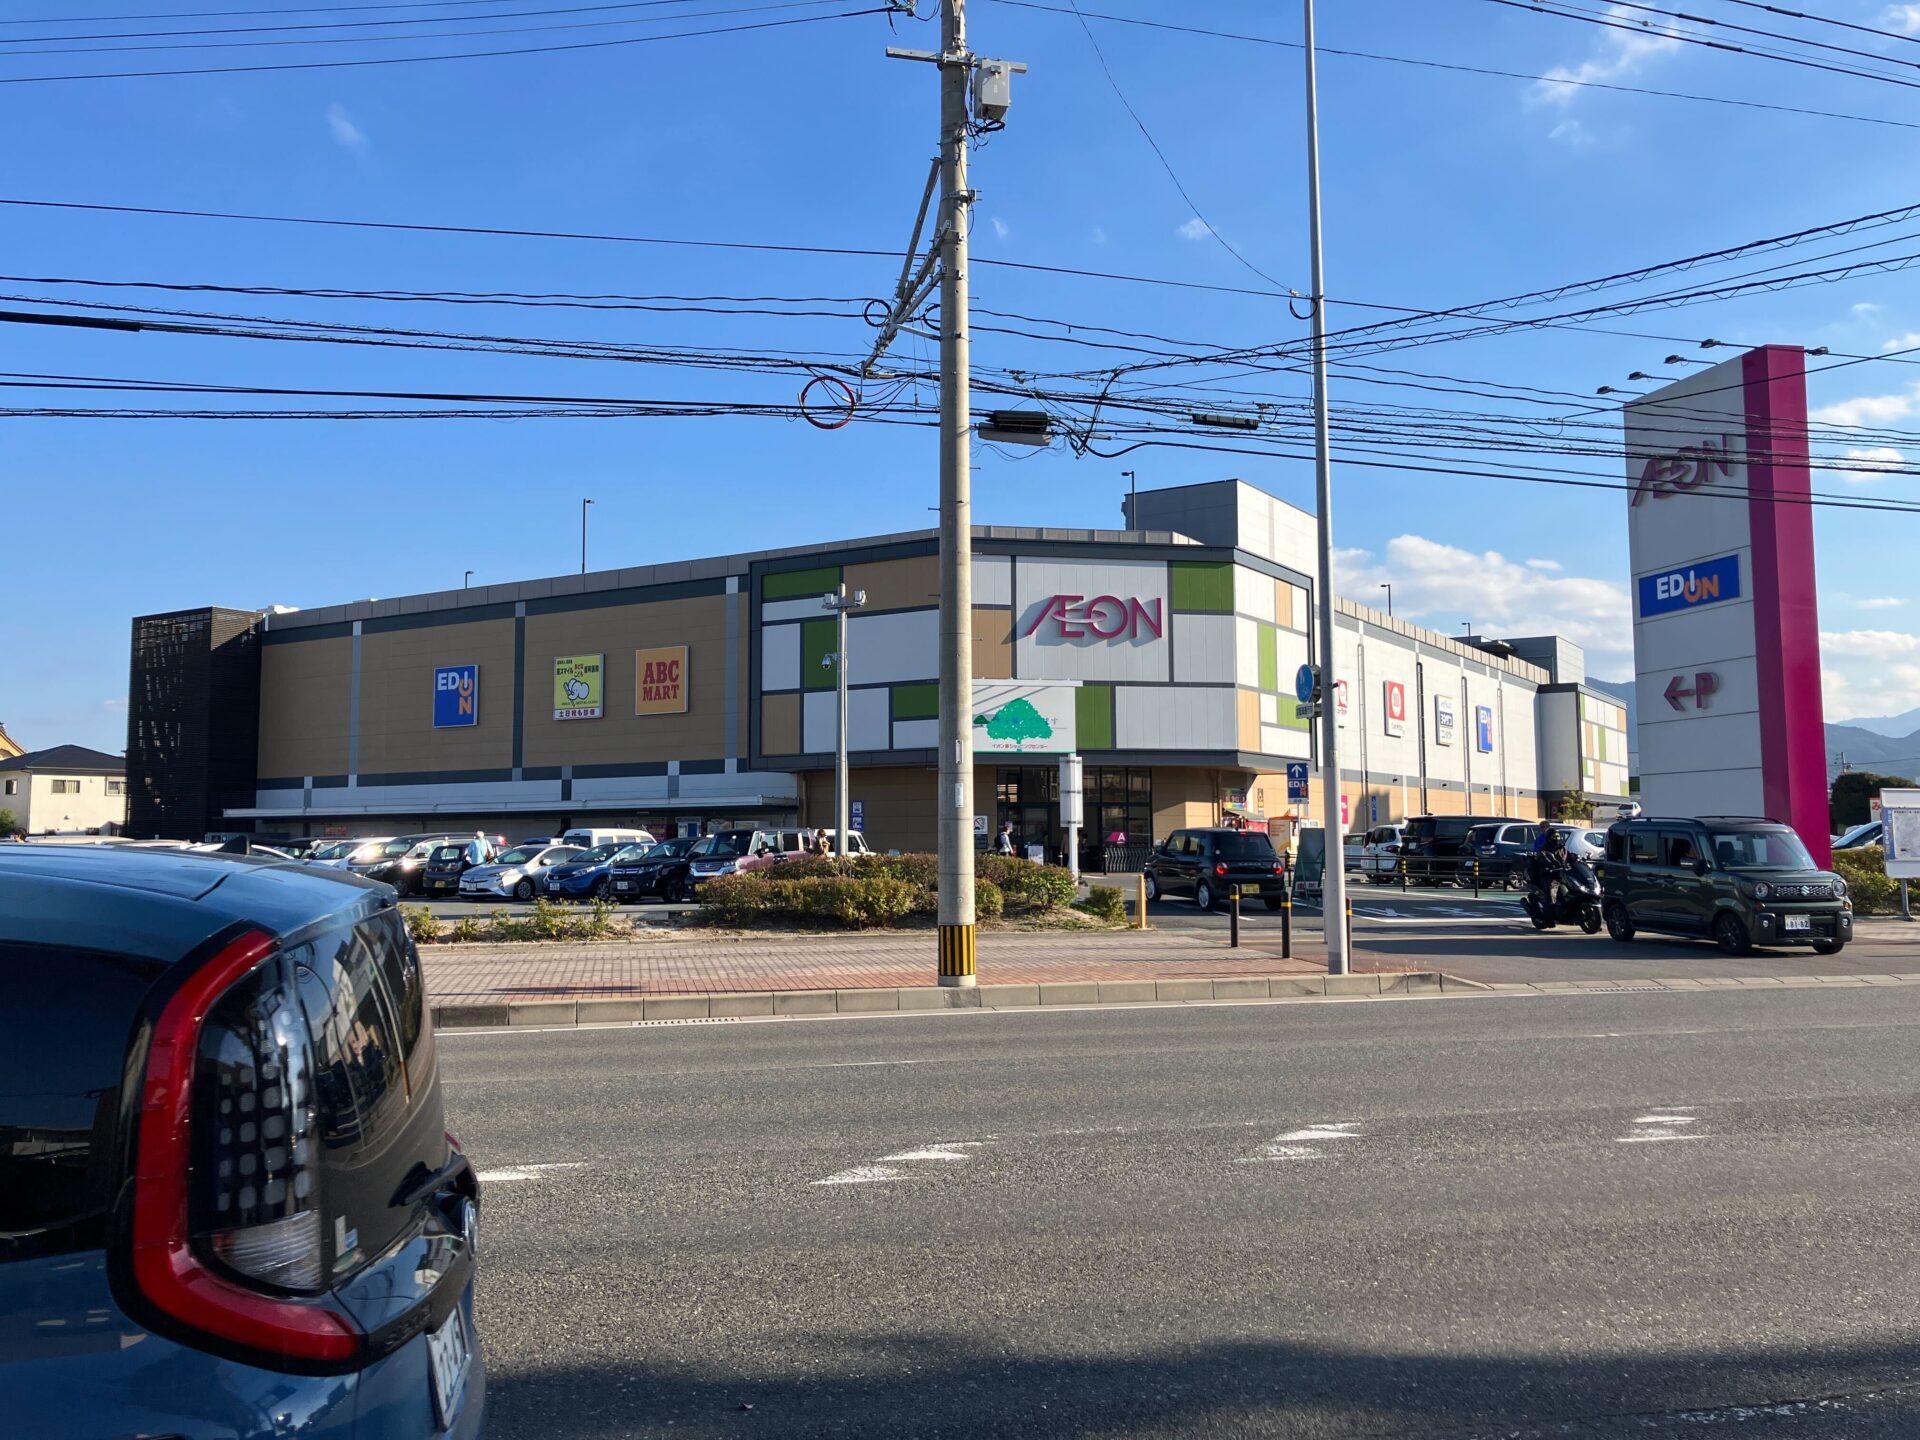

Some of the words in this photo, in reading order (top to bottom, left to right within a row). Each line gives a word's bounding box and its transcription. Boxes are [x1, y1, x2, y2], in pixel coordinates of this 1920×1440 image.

[1656, 570, 1719, 603] EDION
[643, 660, 680, 684] ABC
[438, 671, 472, 714] EDION
[643, 685, 680, 702] MART
[1695, 672, 1718, 709] P
